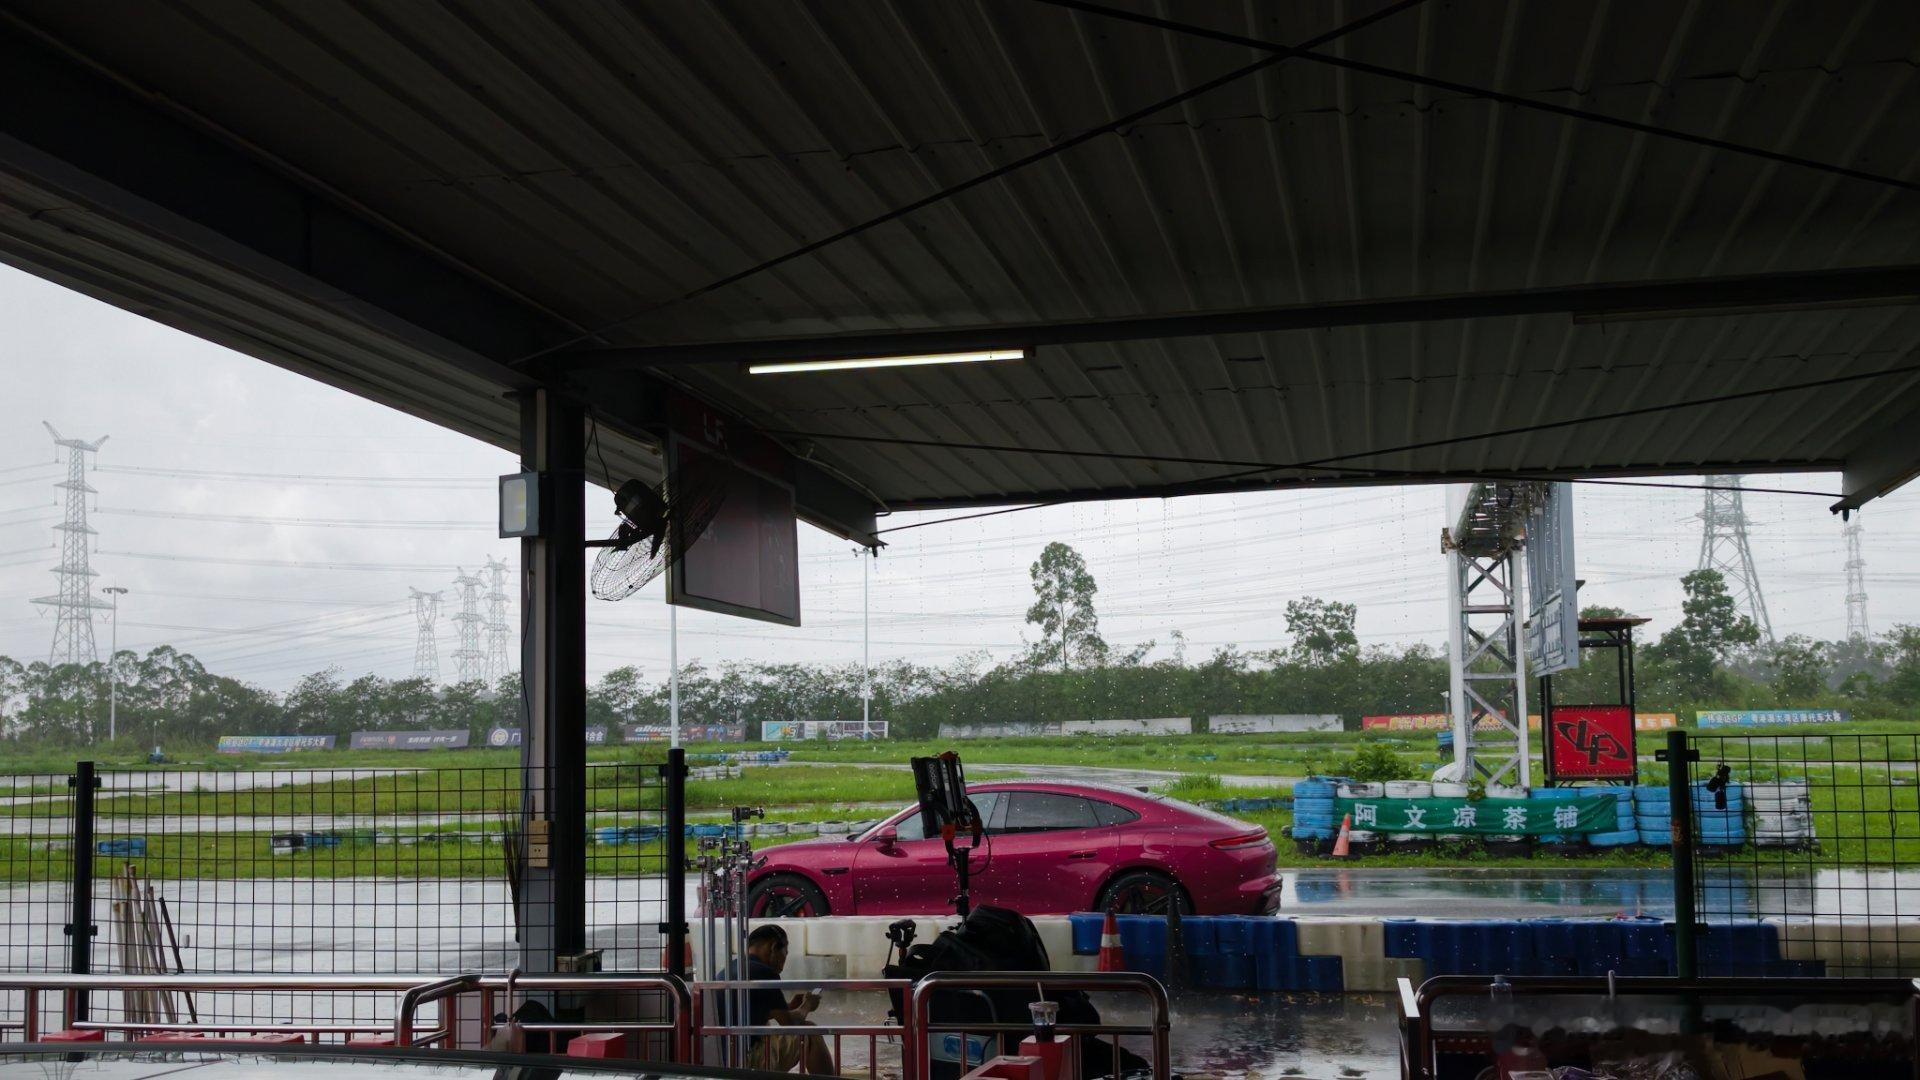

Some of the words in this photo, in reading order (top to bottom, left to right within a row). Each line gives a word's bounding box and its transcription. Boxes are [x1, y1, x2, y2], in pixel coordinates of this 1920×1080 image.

[635, 725, 681, 733] aRace
[1354, 803, 1579, 830] 阿文凉茶铺
